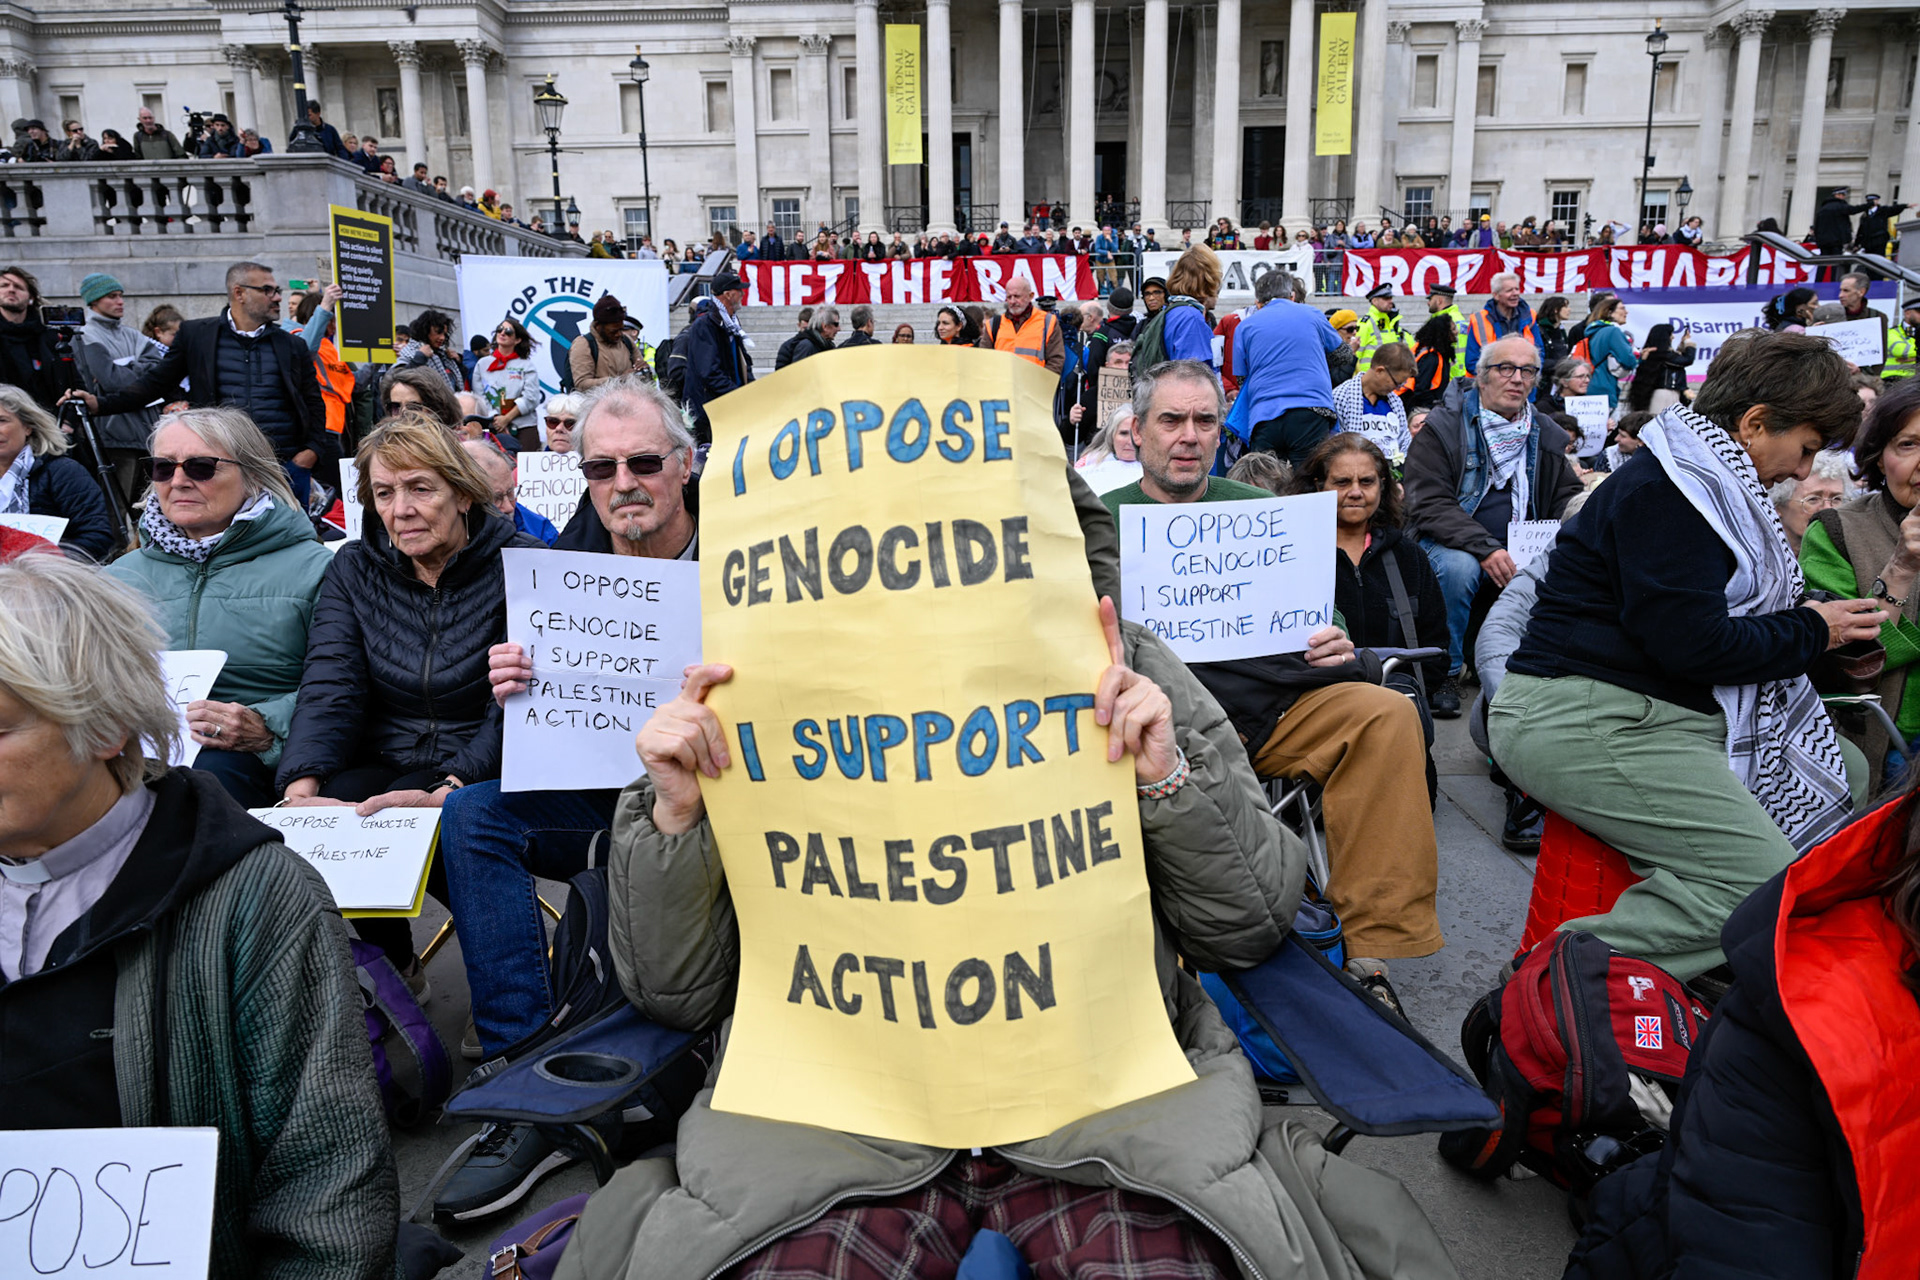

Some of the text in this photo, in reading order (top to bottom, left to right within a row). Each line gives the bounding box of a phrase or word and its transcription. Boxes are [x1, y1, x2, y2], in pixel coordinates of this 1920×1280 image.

[895, 49, 904, 114] NATIONAL
[904, 50, 916, 115] GALLERY
[1326, 37, 1338, 104] NATIONAL
[1336, 38, 1349, 104] GALLERY
[339, 240, 350, 250] This
[351, 243, 366, 252] action
[340, 251, 350, 259] and
[341, 263, 373, 276] Sitting quietly
[341, 273, 383, 286] with banned signs
[745, 255, 1078, 306] LIFT THE BAN
[1345, 250, 1484, 296] DROP
[1499, 251, 1590, 293] THE
[348, 293, 367, 302] courage
[367, 294, 376, 302] and
[356, 283, 372, 292] chosen
[505, 276, 594, 324] TOP THE
[1669, 316, 1743, 334] Disarm
[1100, 388, 1132, 399] GENO
[526, 454, 578, 472] I OPPO
[733, 397, 1012, 497] I OPPOSE
[519, 477, 588, 498] GENOCID
[1142, 508, 1287, 553] I OPPOSE
[1525, 531, 1553, 541] OPPO
[722, 516, 1034, 607] GENOCIDE
[1172, 544, 1297, 576] GENOCIDE
[532, 569, 662, 602] I OPPOSE
[1141, 581, 1253, 611] I SUPPORT
[529, 609, 660, 642] GENOCIDE
[1270, 603, 1329, 634] ACTION
[551, 646, 659, 675] SUPPORT
[527, 677, 657, 709] PALESTINE
[525, 707, 632, 732] ACTION
[737, 693, 1096, 783] I SUPPORT
[279, 816, 340, 829] OPPOSE
[307, 844, 390, 861] PALESTINE
[764, 800, 1122, 906] PALESTINE
[787, 942, 1057, 1030] ACTION
[0, 1162, 184, 1275] POSE
